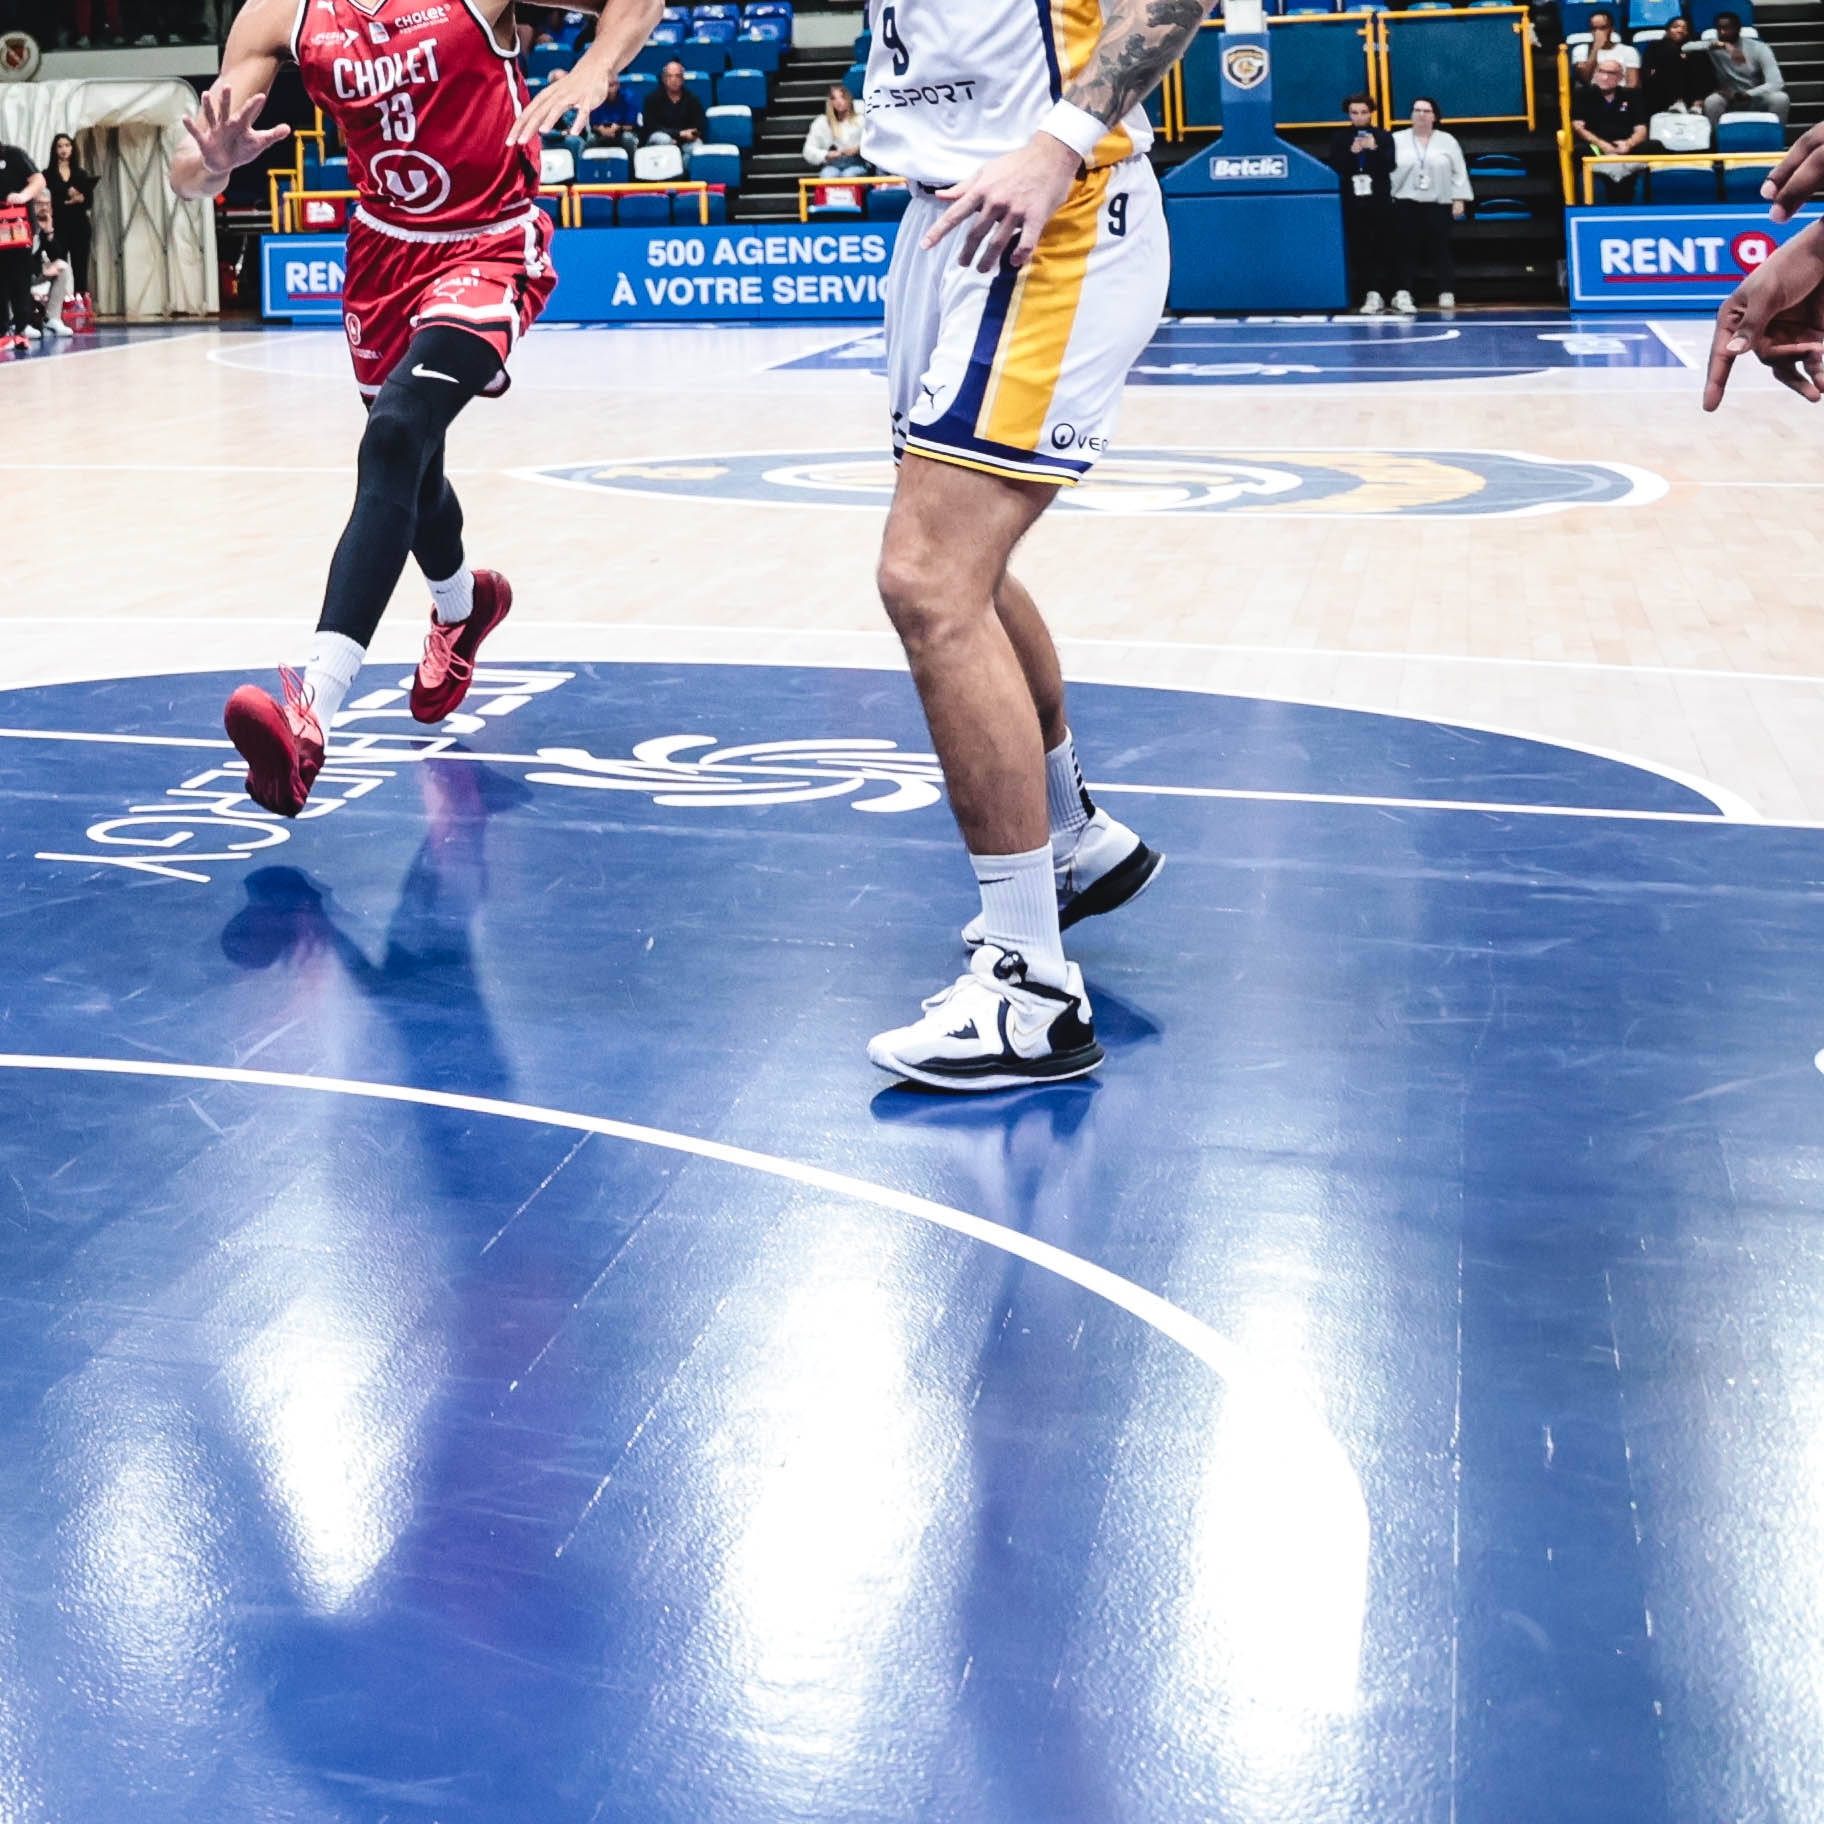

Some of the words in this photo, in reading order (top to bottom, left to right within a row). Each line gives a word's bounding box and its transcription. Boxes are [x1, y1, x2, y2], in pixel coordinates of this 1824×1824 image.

[882, 6, 910, 76] 9
[332, 37, 440, 100] CHOLET
[889, 80, 977, 107] SPORT
[374, 92, 417, 143] 13
[1213, 158, 1285, 176] Betclic
[1107, 192, 1130, 237] 9
[647, 238, 705, 267] 500
[712, 234, 887, 266] AGENCES
[1599, 236, 1726, 274] RENT
[611, 271, 638, 307] À
[644, 276, 764, 306] VOTRE
[772, 274, 888, 304] SERVI
